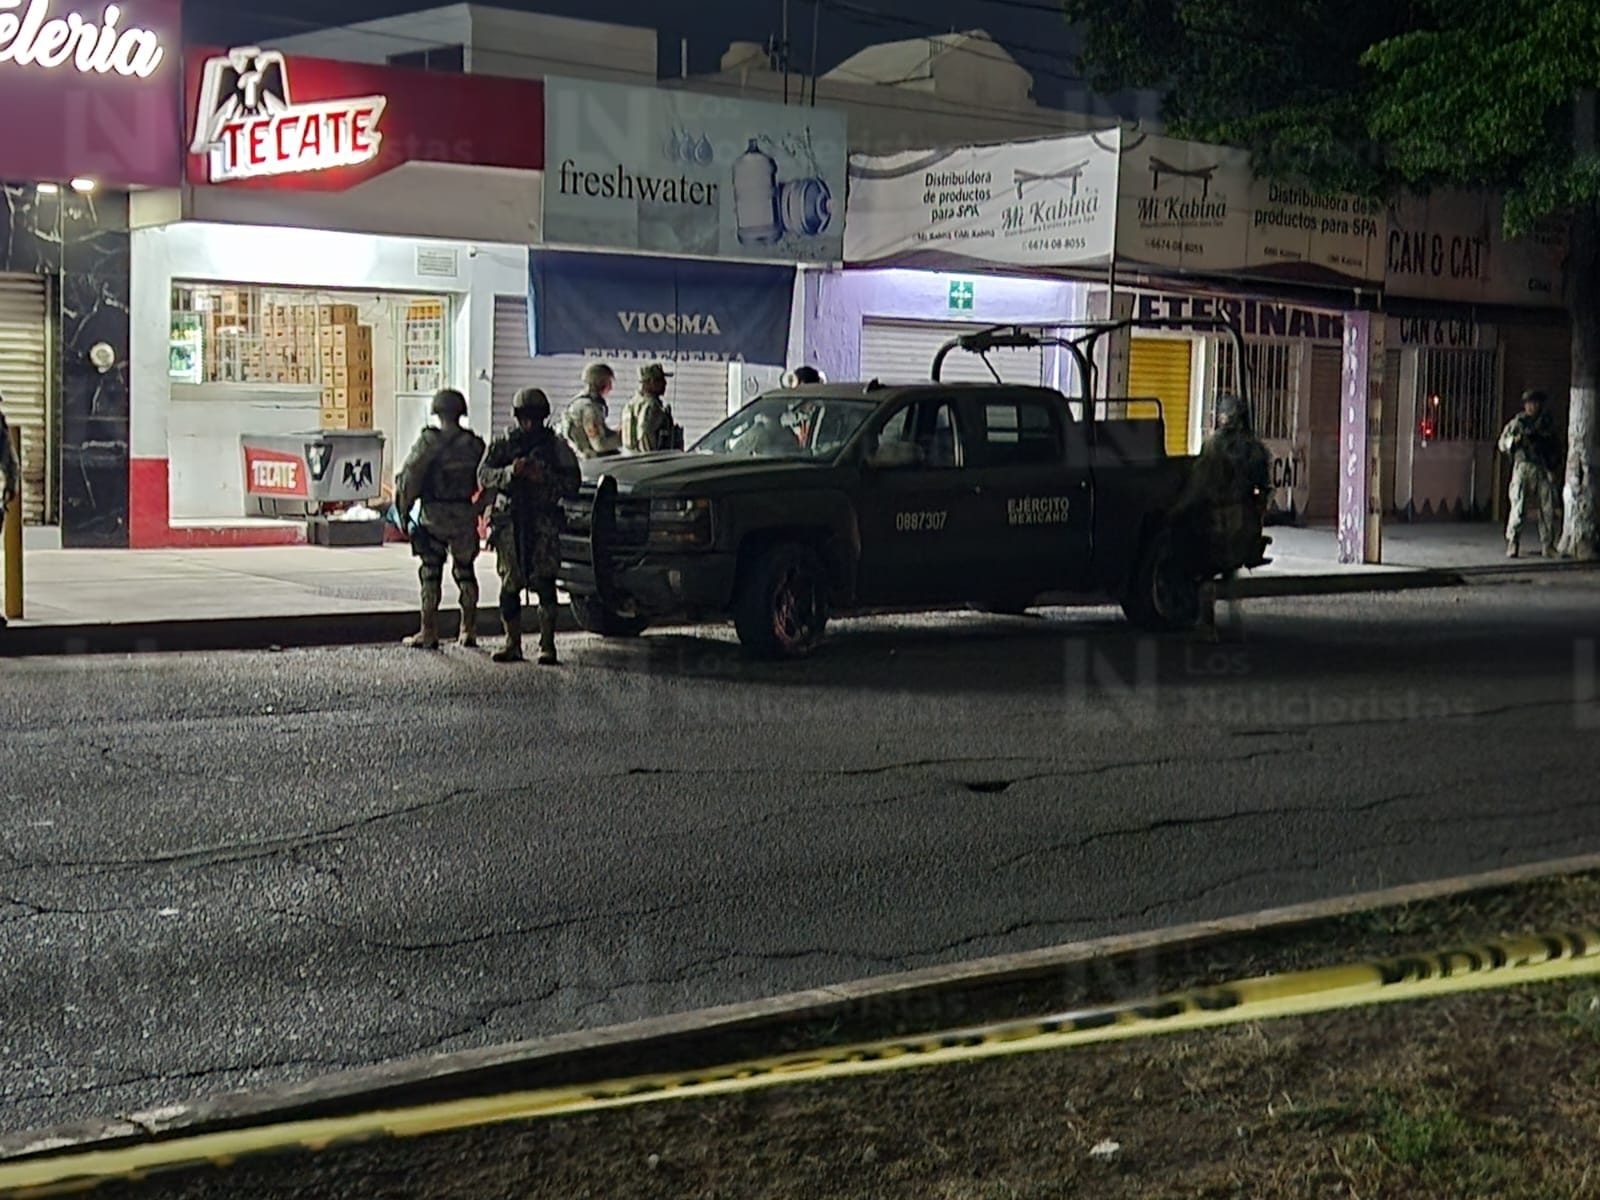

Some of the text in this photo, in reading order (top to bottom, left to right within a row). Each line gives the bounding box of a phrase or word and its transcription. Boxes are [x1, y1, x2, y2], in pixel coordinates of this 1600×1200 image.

[219, 107, 374, 169] TECATE
[559, 159, 718, 206] freshwater
[925, 170, 992, 187] Distribuidora
[923, 187, 992, 207] de productos
[1137, 195, 1227, 221] Mi Kabina
[1268, 183, 1349, 213] Distribuidora
[931, 208, 955, 224] para
[1001, 205, 1024, 230] Mi
[1254, 208, 1377, 238] productos para SPA
[1388, 230, 1483, 281] CAN & CAT
[618, 312, 721, 335] VIOSMA
[1138, 292, 1344, 338] ETERINAR
[1400, 316, 1430, 345] CAN
[252, 460, 298, 489] TECATE
[1272, 457, 1302, 489] CAT
[1008, 511, 1068, 526] MEXICANO
